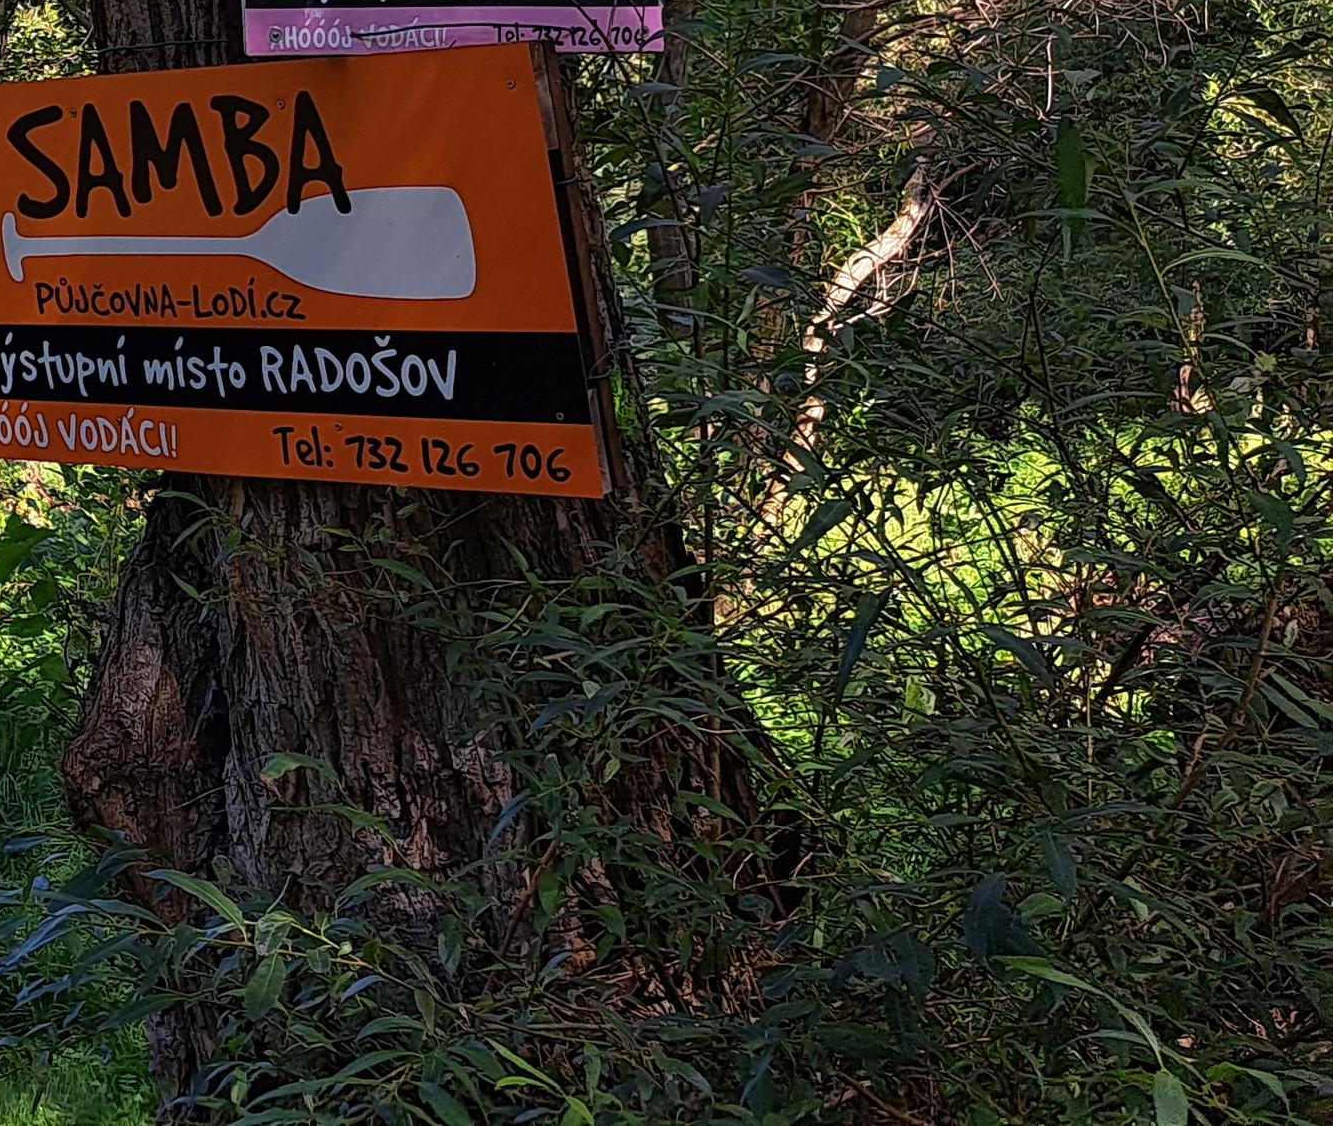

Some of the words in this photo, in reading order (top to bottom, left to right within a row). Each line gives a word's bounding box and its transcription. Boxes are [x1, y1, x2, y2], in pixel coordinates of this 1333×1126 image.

[359, 16, 447, 50] VODÁCI!
[570, 26, 601, 46] 126
[6, 90, 353, 220] SAMBA
[144, 337, 247, 396] místo
[260, 335, 458, 400] RADOŠOV
[58, 406, 178, 460] VODÁCI!
[272, 425, 334, 469] Tel:
[344, 433, 406, 475] 732
[420, 438, 480, 478] 126
[494, 443, 572, 482] 706
